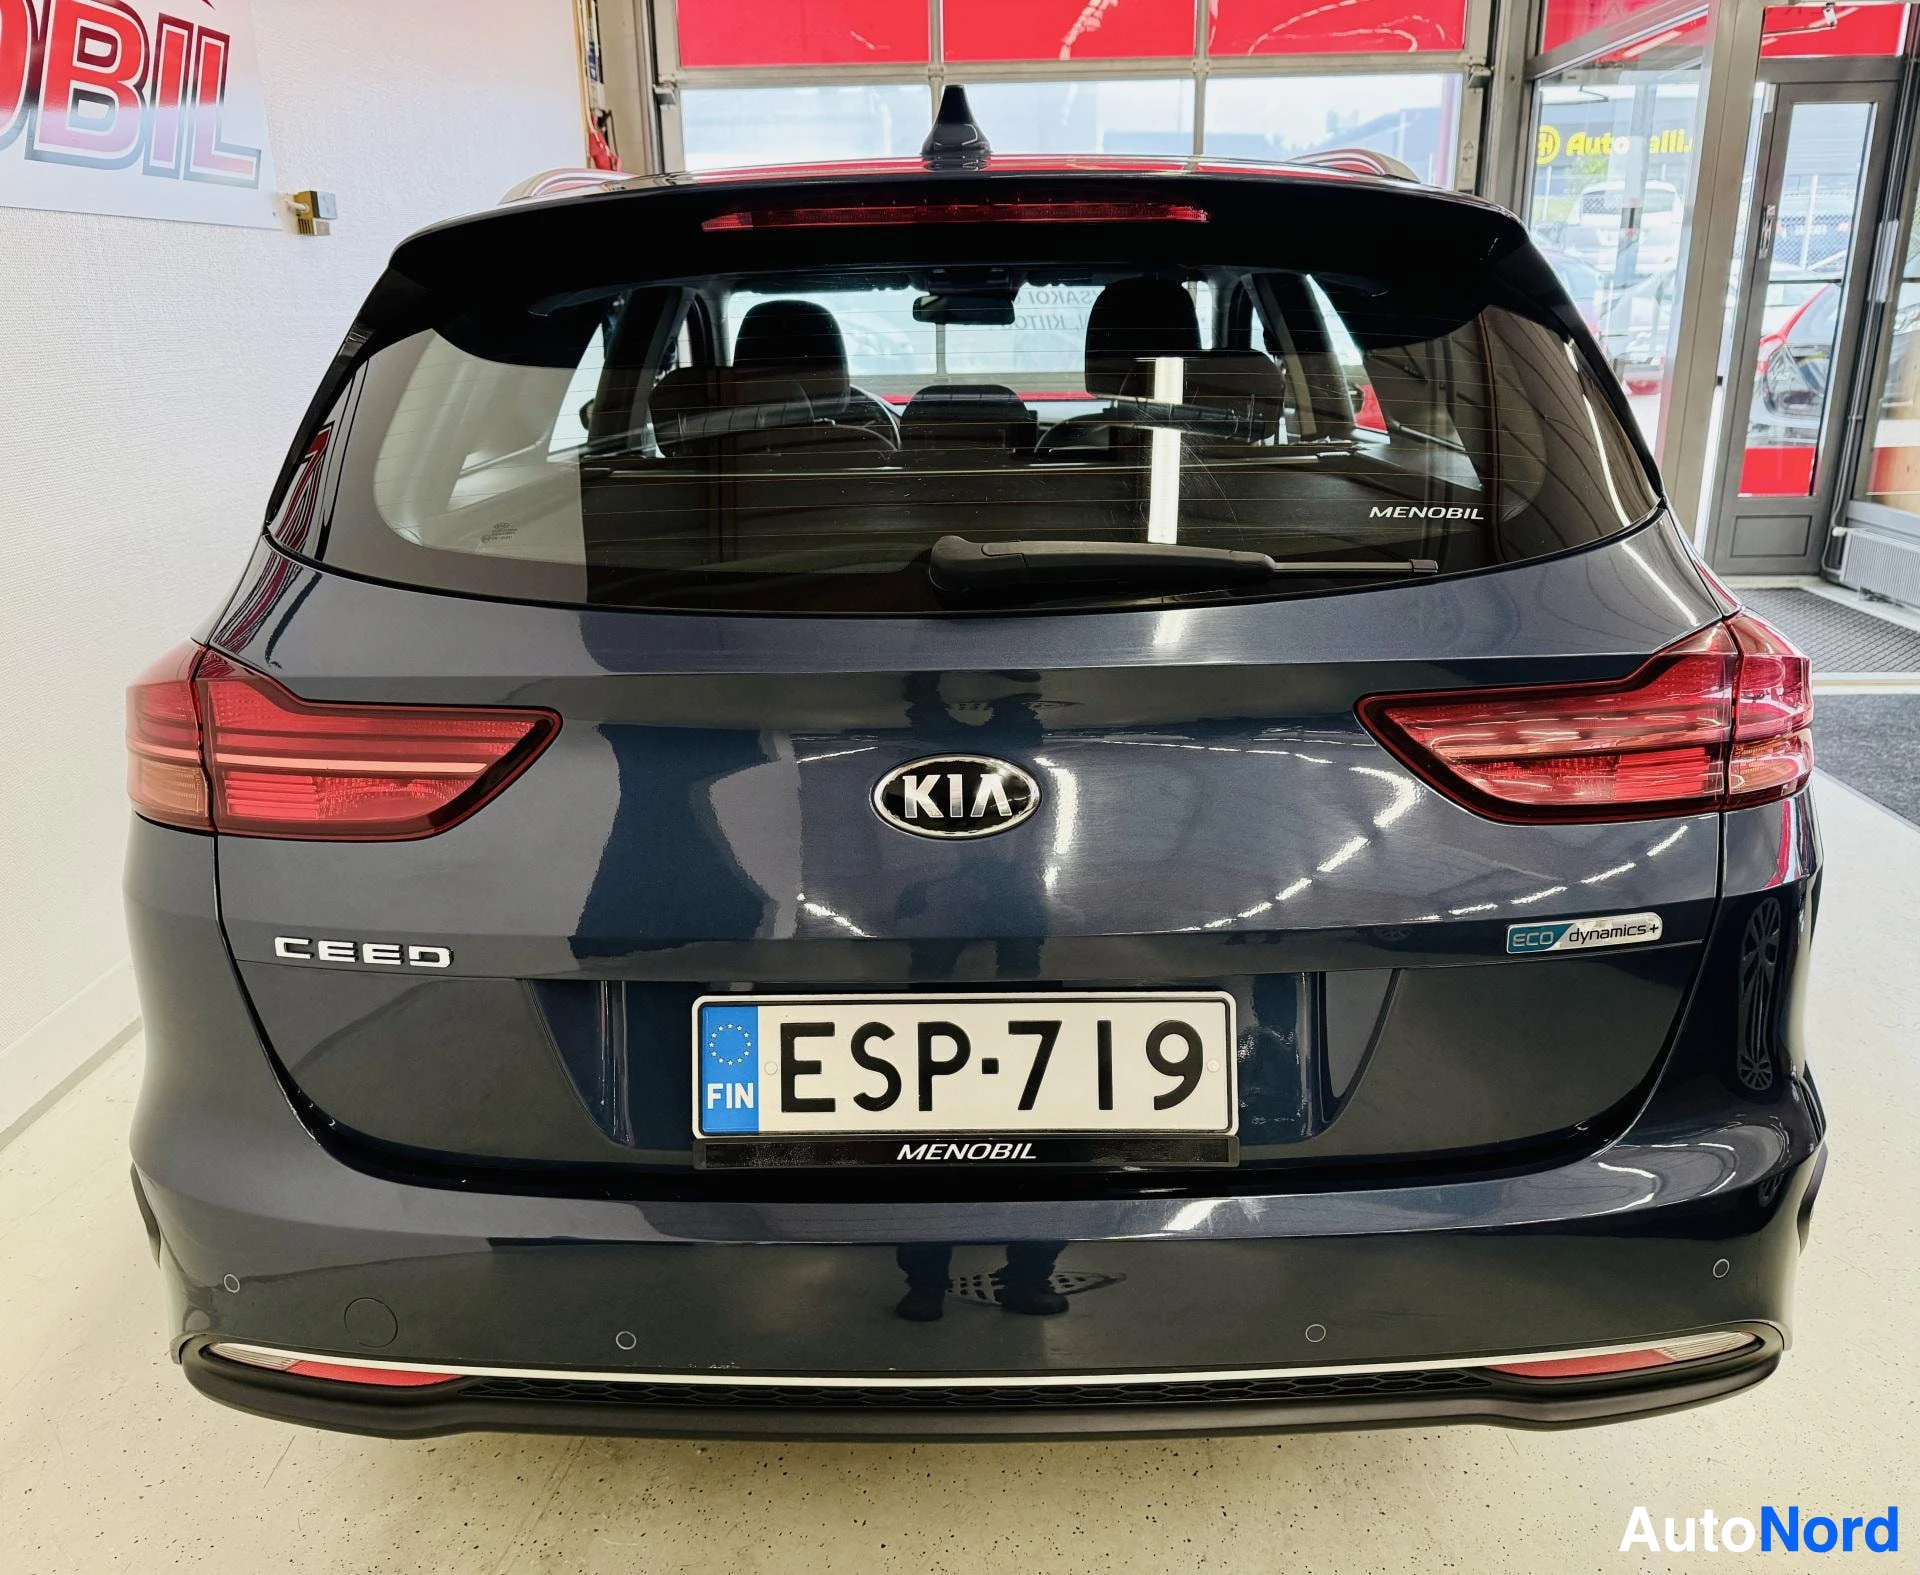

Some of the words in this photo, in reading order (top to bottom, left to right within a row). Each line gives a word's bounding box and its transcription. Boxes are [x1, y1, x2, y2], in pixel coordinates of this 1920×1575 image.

[1369, 506, 1485, 520] MENOBIL
[902, 773, 1013, 819] KIA
[274, 936, 454, 968] CEED
[1512, 931, 1554, 947] ECO
[780, 1020, 1205, 1113] ESP-719
[706, 1082, 754, 1110] FIN
[896, 1142, 1037, 1161] MENOBIL
